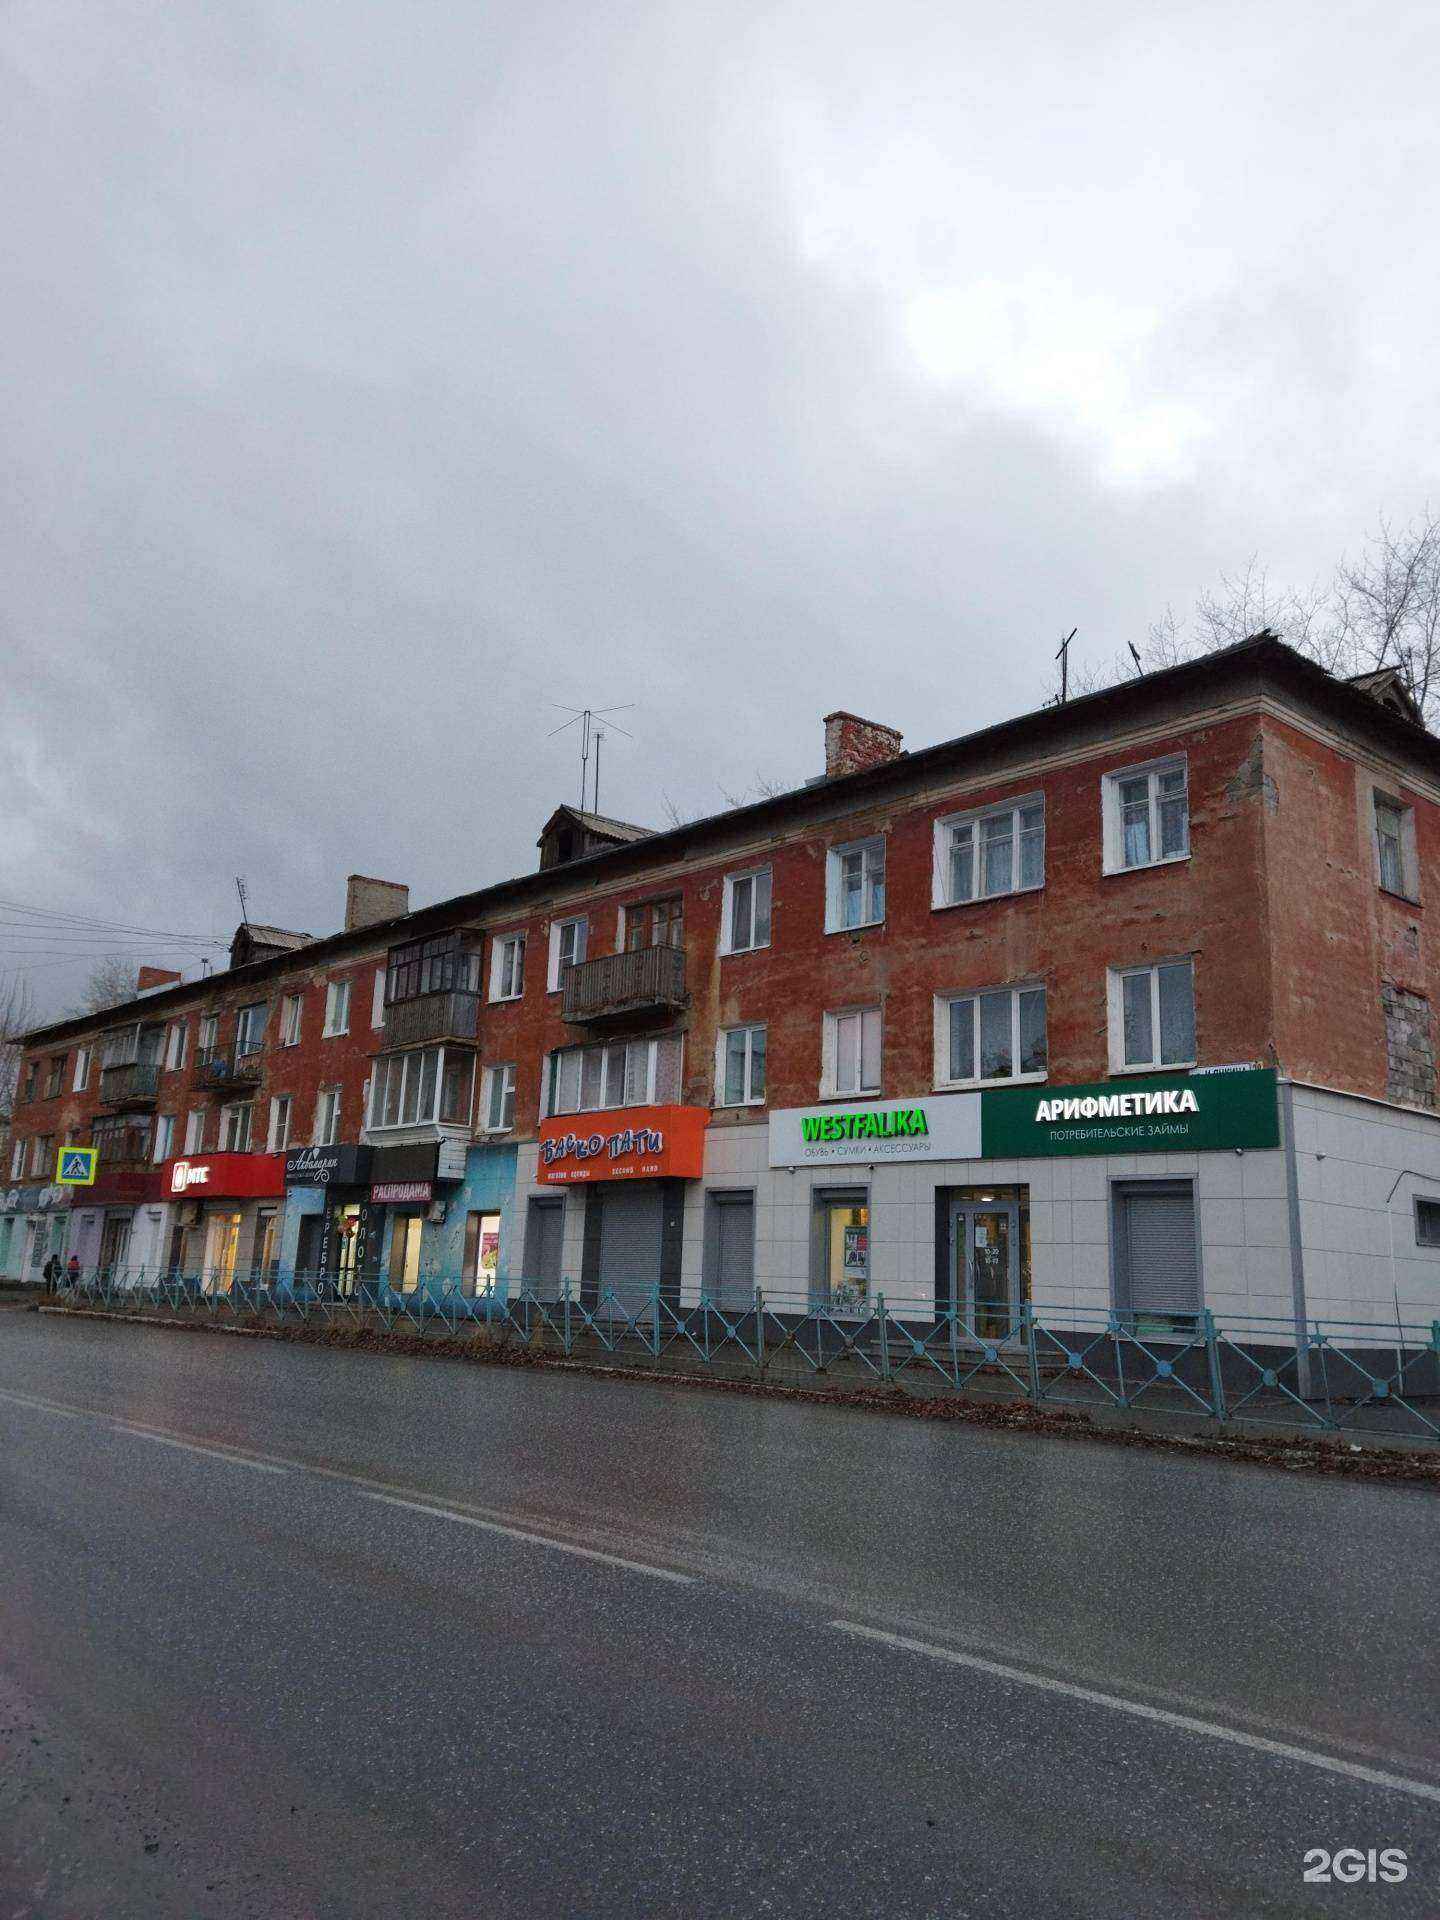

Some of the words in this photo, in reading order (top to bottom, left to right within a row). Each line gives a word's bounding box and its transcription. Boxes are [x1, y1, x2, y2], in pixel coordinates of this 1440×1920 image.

[1035, 1089, 1199, 1122] АРИФМЕТИКА
[801, 1108, 928, 1142] WESTFALIKA
[1050, 1126, 1144, 1141] ПОТРЕБИТЕЛЬСКИЕ
[1147, 1123, 1189, 1137] ЗАЙМЫ
[539, 1133, 604, 1164] БАСКО
[606, 1128, 662, 1160] ПАТИ
[803, 1147, 829, 1158] ОБУВЬ
[837, 1145, 866, 1156] СУМКИ
[874, 1142, 931, 1154] АКСЕССУАРЫ
